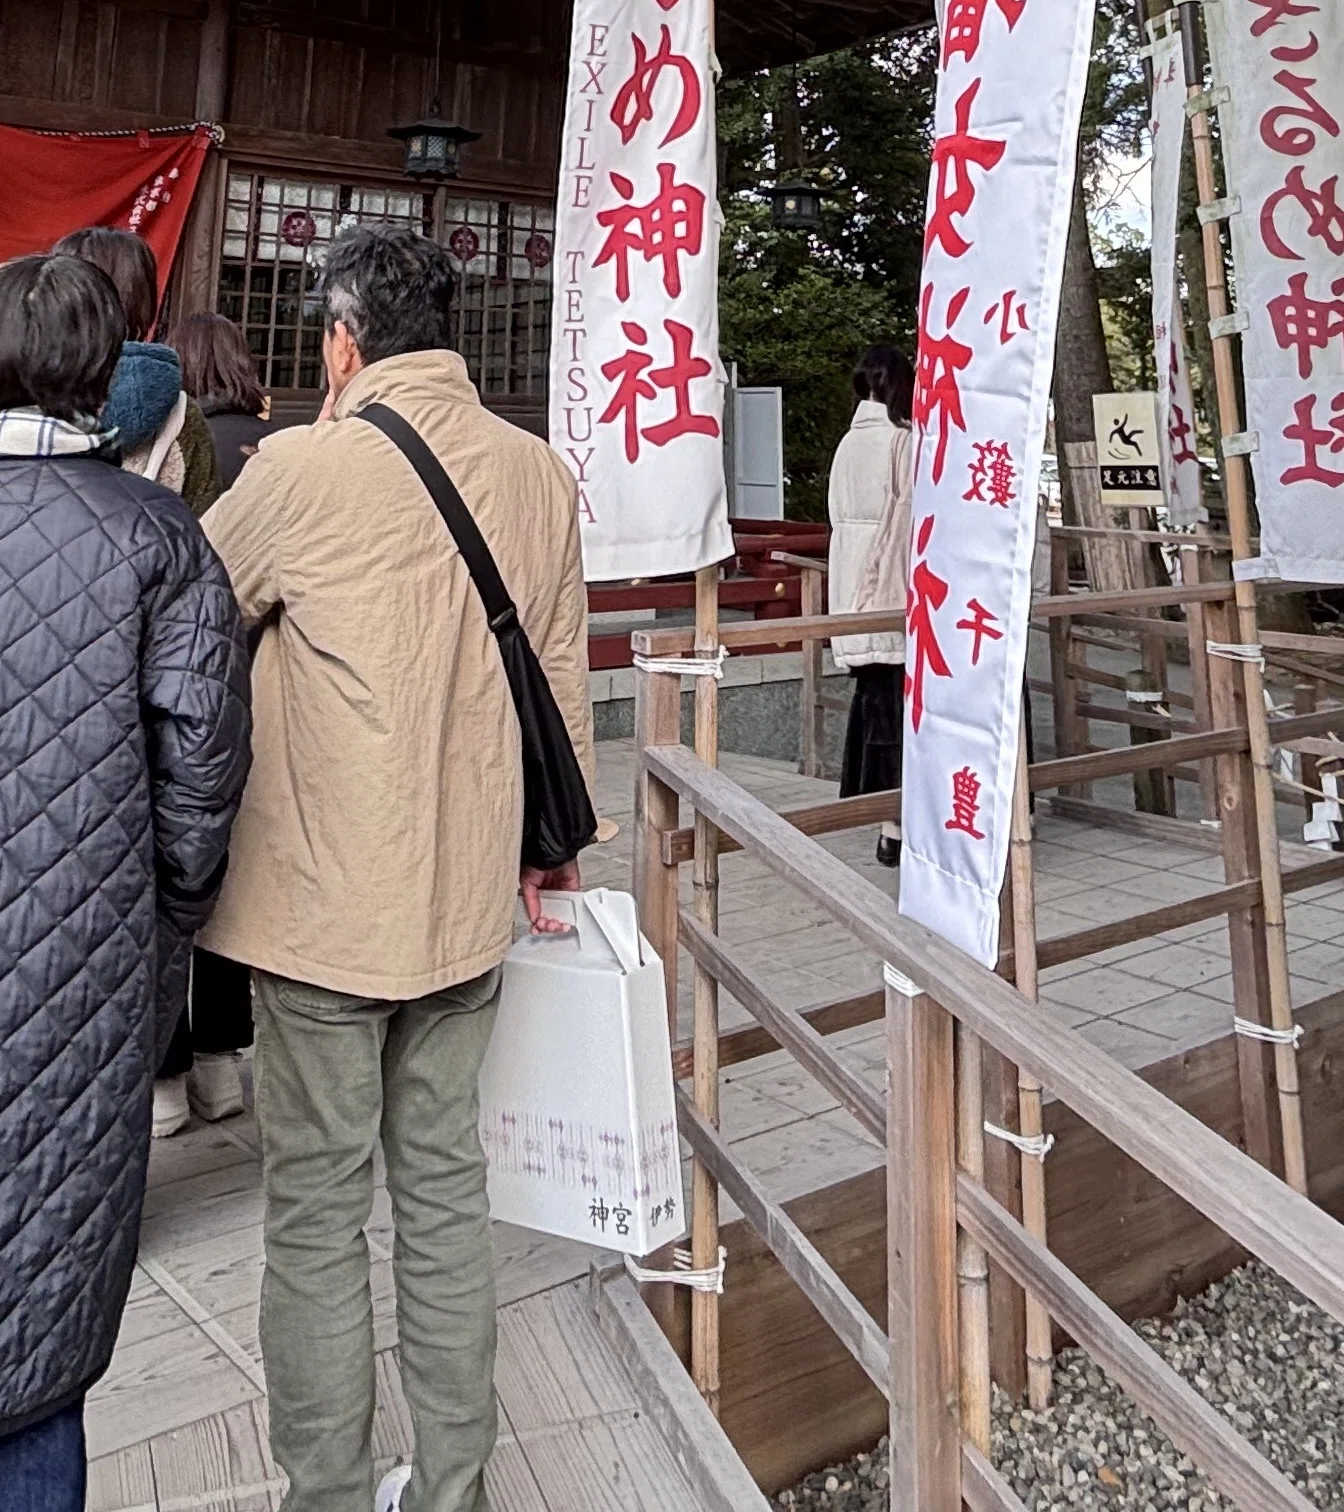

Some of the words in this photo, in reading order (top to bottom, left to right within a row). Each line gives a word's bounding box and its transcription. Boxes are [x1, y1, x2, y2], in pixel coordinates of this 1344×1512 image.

[570, 23, 609, 209] EXILE
[563, 250, 597, 525] TETSUYA
[1103, 469, 1157, 486] 足元注意
[589, 1197, 632, 1235] 神宮
